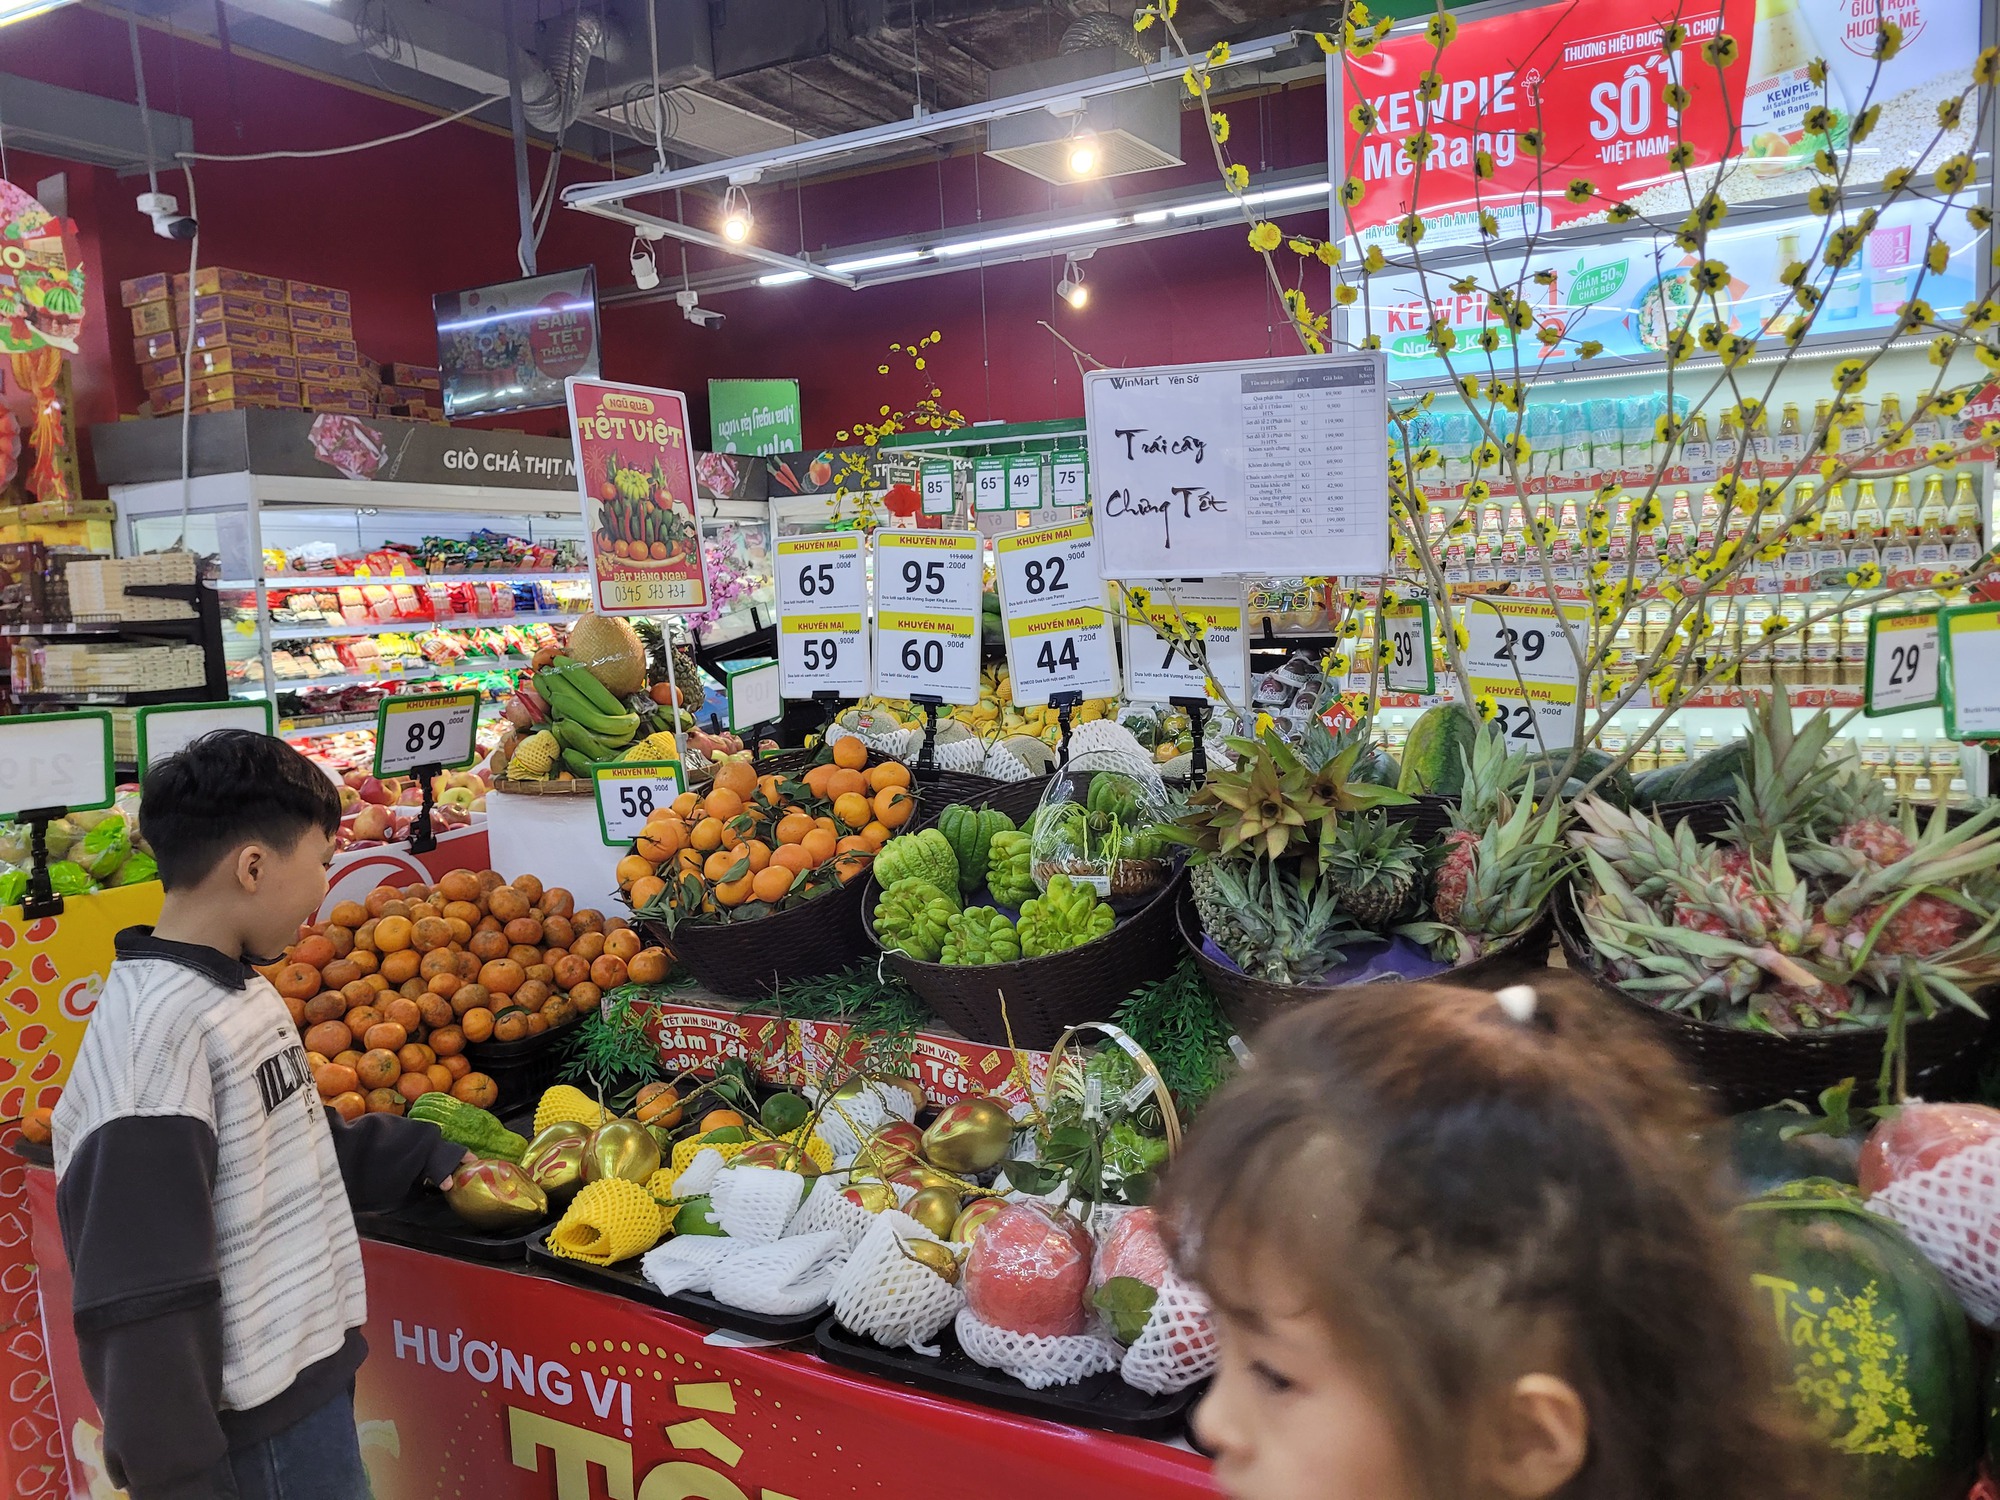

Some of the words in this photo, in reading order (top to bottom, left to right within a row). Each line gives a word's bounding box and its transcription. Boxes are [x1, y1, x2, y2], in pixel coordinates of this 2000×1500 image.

[1564, 41, 1607, 62] THƯƠNG
[1608, 34, 1634, 53] HIỆU
[1365, 71, 1516, 137] KEWPIE
[1590, 55, 1661, 140] SỐ
[1658, 50, 1683, 128] 1
[1767, 81, 1811, 104] KEWPIE
[1773, 97, 1791, 109] Salad
[1791, 90, 1819, 104] Dressing
[1773, 107, 1786, 119] Mè
[1787, 101, 1810, 116] Rang
[1425, 128, 1516, 171] Rang
[1439, 213, 1454, 229] TÔI
[1497, 205, 1515, 219] RAU
[1576, 275, 1599, 291] GIẢM
[1601, 266, 1623, 283] 50%
[1578, 286, 1599, 301] CHẤT
[1600, 282, 1617, 295] BÉO
[1387, 293, 1503, 333] KEWPI
[1110, 376, 1160, 390] WinMart
[1168, 376, 1185, 385] Yên
[740, 412, 753, 438] tại
[752, 406, 775, 431] ngay
[774, 403, 795, 427] Mua
[718, 418, 740, 441] vườn
[1114, 428, 1168, 461] Trái
[1171, 435, 1207, 464] cây
[443, 447, 479, 470] GIÒ
[482, 449, 521, 473] CHẢ
[524, 456, 563, 480] THỊT
[927, 481, 943, 494] 85
[981, 476, 997, 490] 65
[1013, 474, 1030, 488] 49
[1058, 470, 1076, 484] 75
[1171, 486, 1229, 519] Tết
[794, 540, 825, 551] KHUYẾN
[826, 539, 841, 551] MẠI
[900, 535, 937, 546] KHUYẾN
[939, 538, 957, 548] MẠI
[1016, 531, 1053, 547] KHUYẾN
[1055, 528, 1072, 540] MẠI
[799, 564, 835, 597] 65
[902, 560, 945, 595] 95
[1024, 556, 1069, 596] 82
[615, 584, 642, 603] 0345
[1028, 618, 1065, 633] KHUYẾN
[1066, 616, 1084, 628] MẠI
[1541, 606, 1559, 618] MẠ
[798, 619, 829, 631] KHUYẾN
[830, 621, 845, 632] MẠI
[898, 619, 936, 630] KHUYẾN
[938, 622, 955, 633] MẠI
[804, 638, 838, 671] 59
[901, 638, 944, 673] 60
[1036, 637, 1080, 674] 44
[1394, 631, 1413, 667] 39
[1493, 628, 1545, 662] 29
[1888, 644, 1920, 686] 29
[1530, 689, 1551, 700] MẠI
[405, 720, 445, 753] 89
[619, 785, 655, 818] 58
[664, 1015, 679, 1026] TẾT
[681, 1016, 699, 1025] WIN
[701, 1018, 718, 1029] SUM
[658, 1027, 707, 1051] Sắm
[710, 1032, 749, 1062] Tết
[916, 1042, 936, 1056] SUM
[926, 1059, 970, 1094] Tết
[984, 1060, 999, 1073] 50%
[393, 1319, 573, 1406] HƯƠNG
[580, 1370, 634, 1439] VỊ
